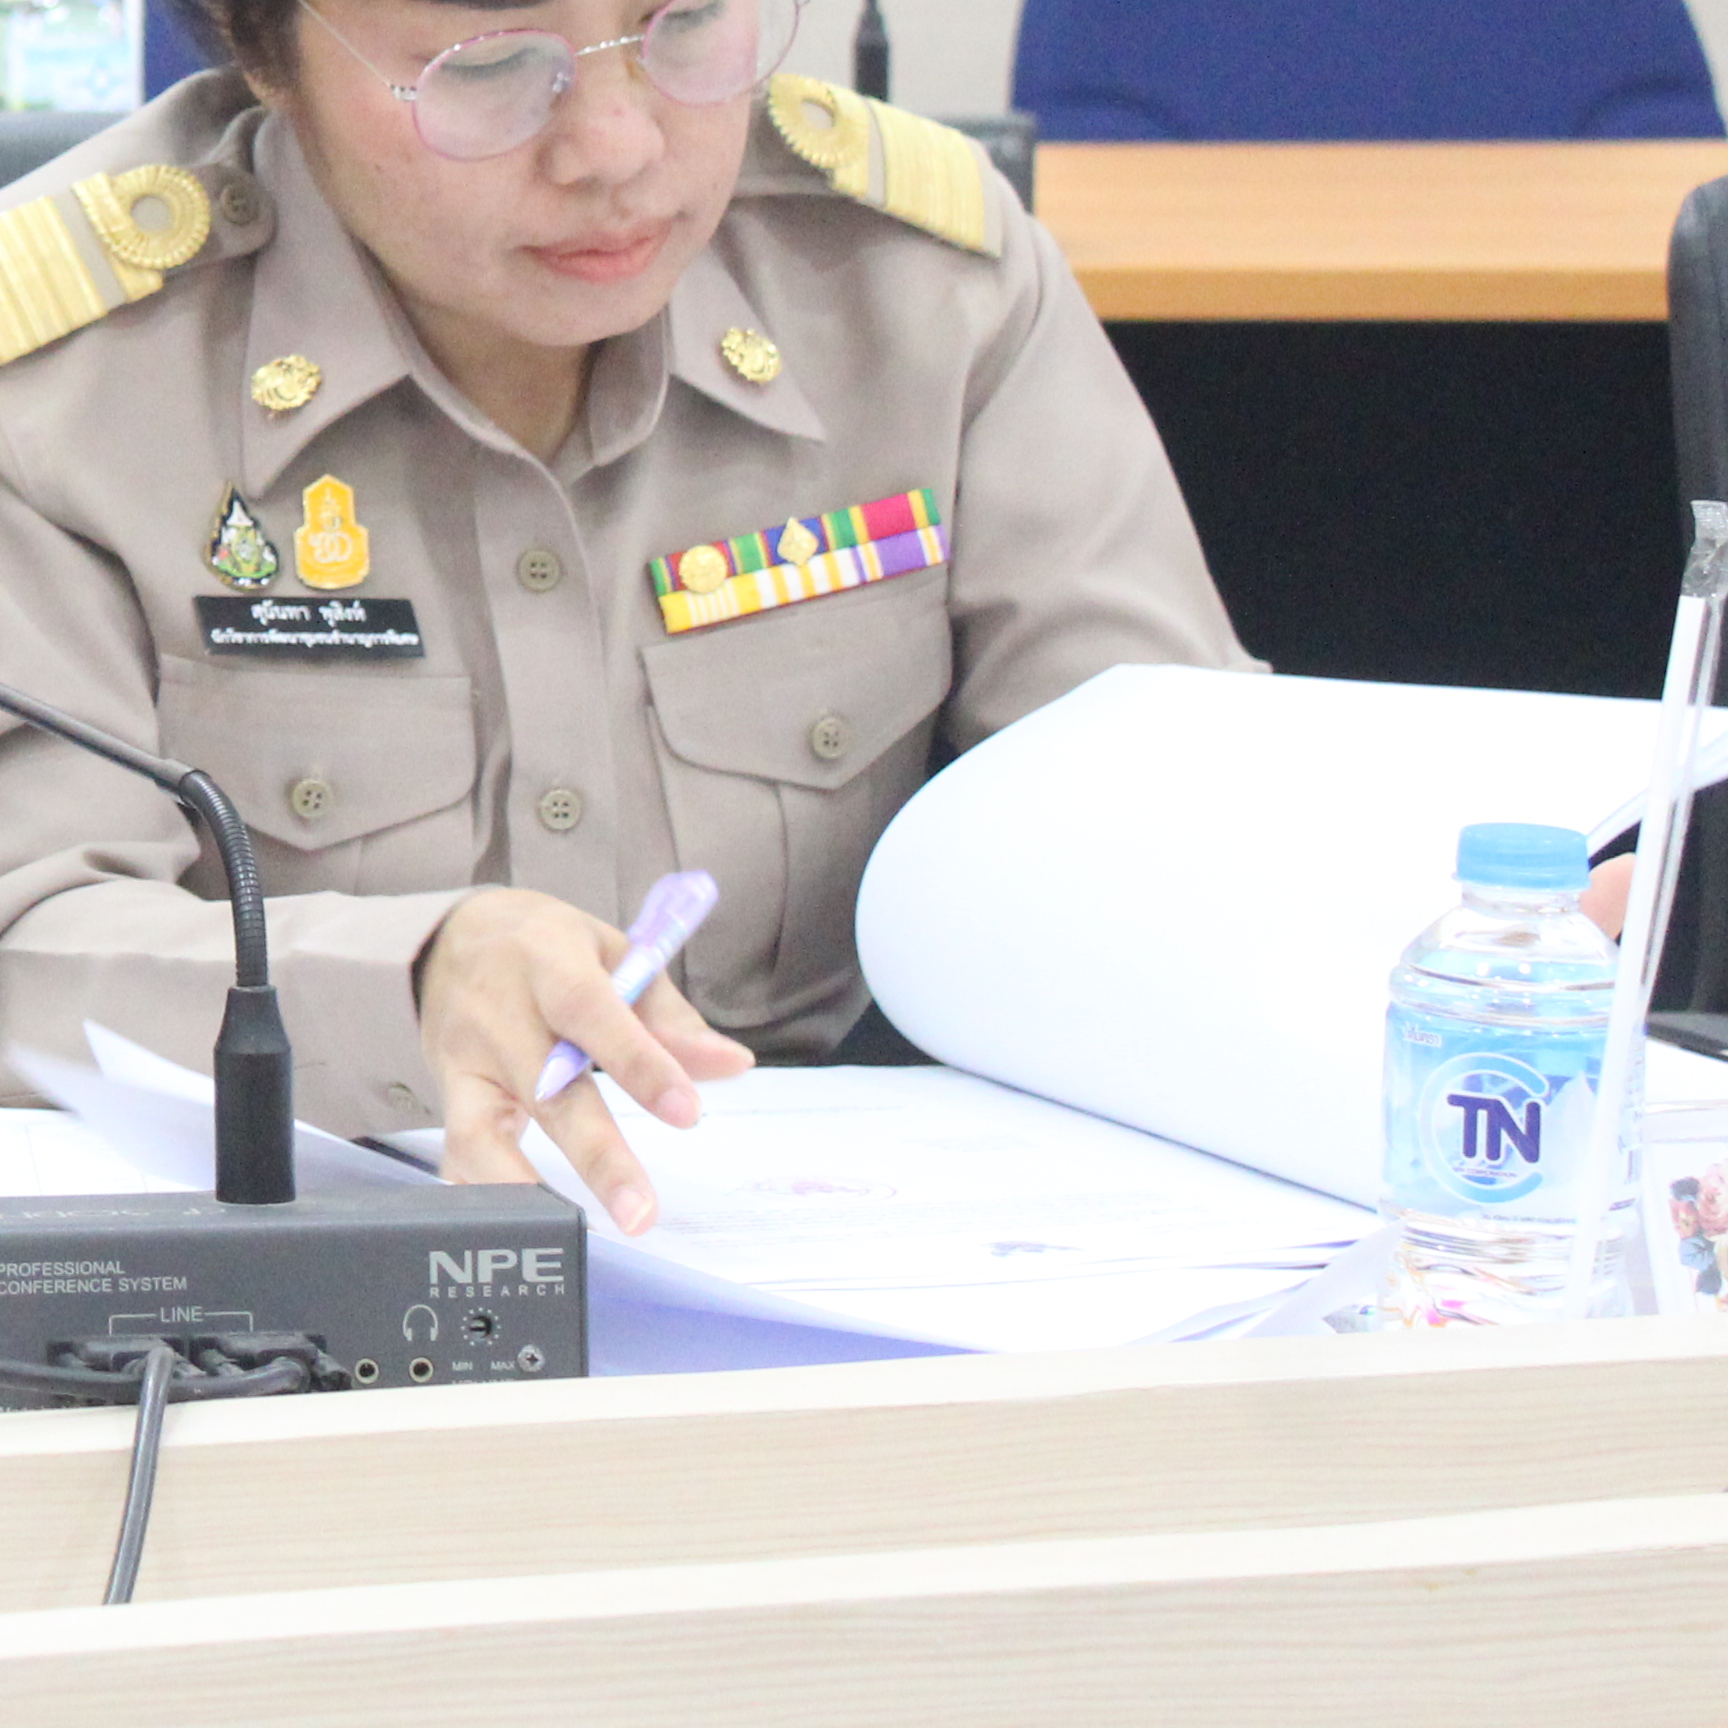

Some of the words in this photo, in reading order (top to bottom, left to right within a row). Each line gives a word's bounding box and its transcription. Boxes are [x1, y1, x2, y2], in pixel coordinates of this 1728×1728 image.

[1446, 1092, 1542, 1164] TN
[428, 1247, 565, 1285] NPE
[118, 1276, 188, 1292] SYSTEM
[429, 1284, 566, 1299] RESEARCH
[159, 1306, 204, 1323] LINE
[451, 1360, 474, 1372] MIN
[489, 1359, 516, 1372] MAX
